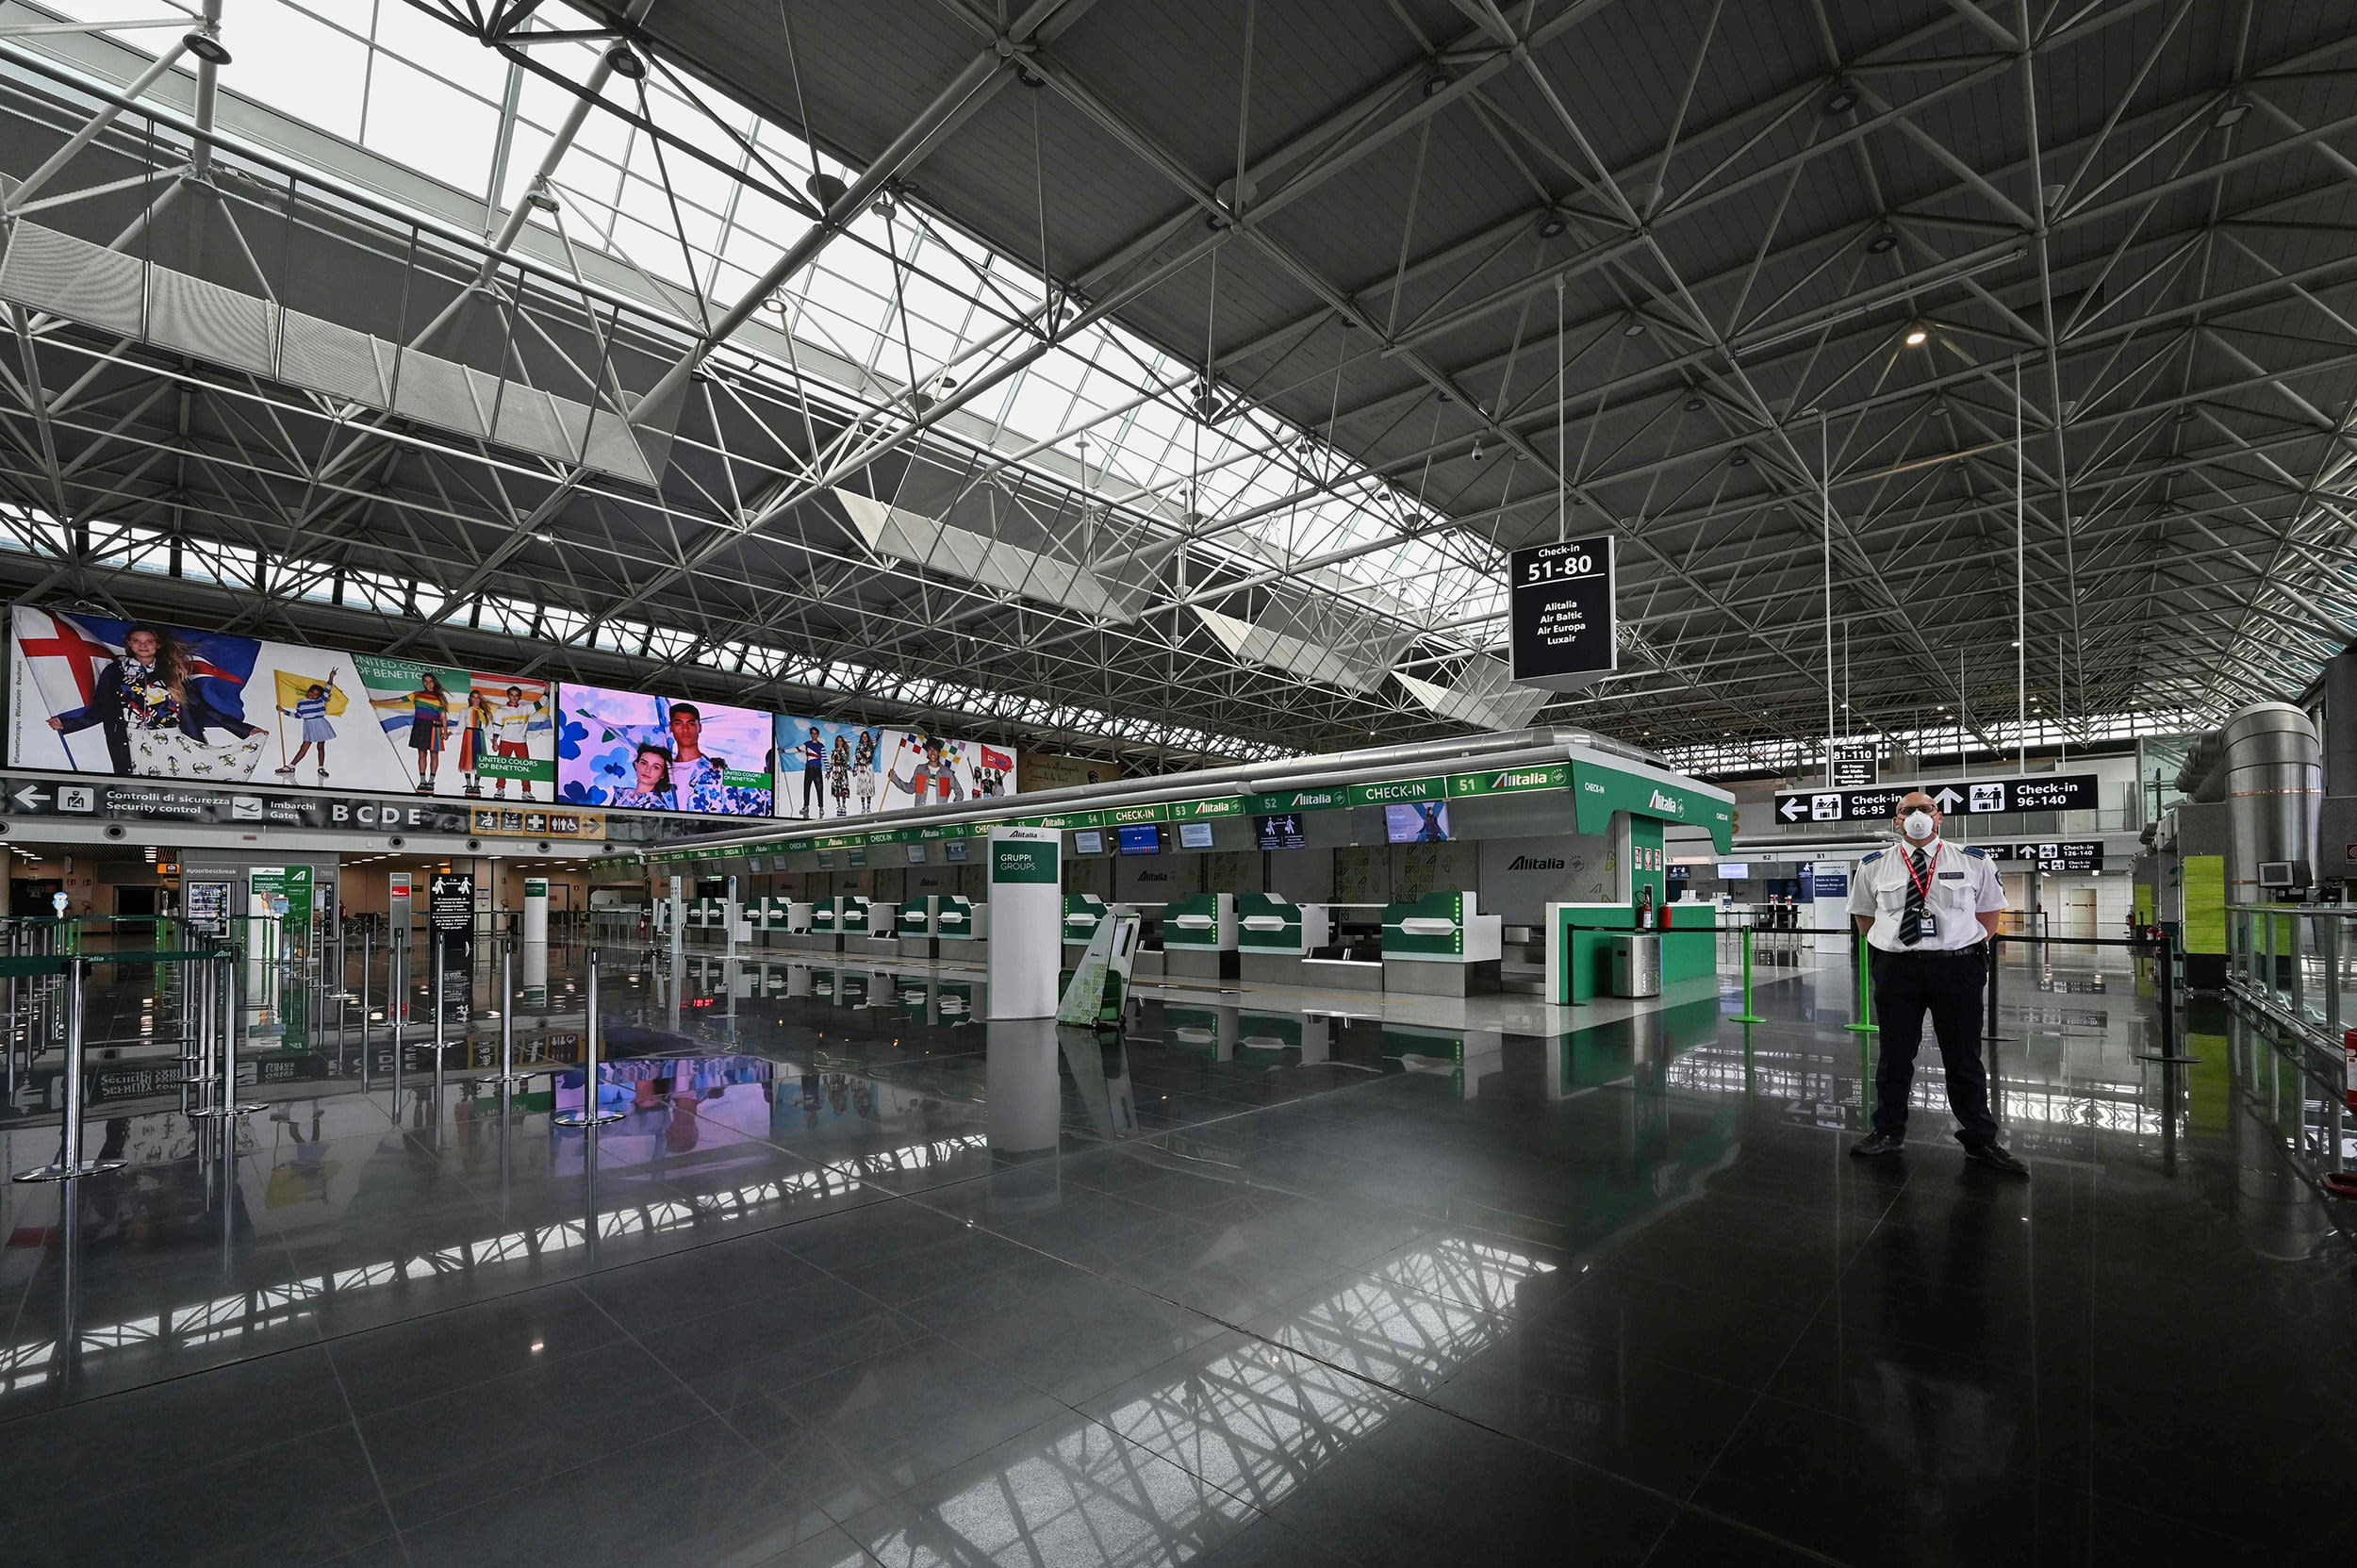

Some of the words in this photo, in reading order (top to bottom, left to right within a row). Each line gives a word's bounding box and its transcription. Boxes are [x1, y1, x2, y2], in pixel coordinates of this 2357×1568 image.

[1539, 544, 1580, 557] Check-in
[1528, 555, 1591, 581] 51-80
[1544, 601, 1577, 612] Alitalia
[1540, 615, 1554, 624] Air
[1557, 611, 1583, 621] Baltic
[1538, 627, 1552, 635] Air
[1554, 622, 1586, 634] Europa
[1547, 635, 1576, 645] Luxair
[373, 668, 424, 680] BENETTO
[400, 661, 446, 675] COLORS
[478, 756, 507, 765] UNITED
[508, 758, 537, 767] COLORS
[1834, 751, 1871, 759] 81-110
[1459, 779, 1475, 791] 51
[1492, 772, 1547, 789] Alitalia
[1366, 784, 1426, 800] CHECK-IN
[1585, 783, 1605, 794] CHECK-IN
[2017, 783, 2078, 795] Check-in
[107, 791, 159, 801] Controlli
[162, 793, 174, 802] di
[178, 795, 230, 805] sicurezza
[1264, 798, 1277, 809] 52
[1292, 793, 1331, 807] Alitalia
[1649, 789, 1676, 813] Alitalia
[1852, 794, 1902, 804] Check-in
[2018, 796, 2067, 806] 96-140
[107, 801, 156, 812] Security
[159, 804, 201, 814] control
[271, 801, 316, 811] Imbarchi
[1176, 806, 1186, 816] 53
[1195, 801, 1229, 814] Alitalia
[1852, 806, 1886, 815] 66-95
[271, 811, 300, 820] Gates
[332, 804, 349, 822] B
[356, 806, 373, 823] C
[382, 807, 400, 824] D
[408, 809, 421, 825] E
[1041, 817, 1065, 828] Alitalia
[1088, 814, 1097, 824] 54
[1116, 809, 1155, 821] CHECK-IN
[870, 834, 892, 843] CHECK-IN
[1508, 855, 1565, 870] Alitalia
